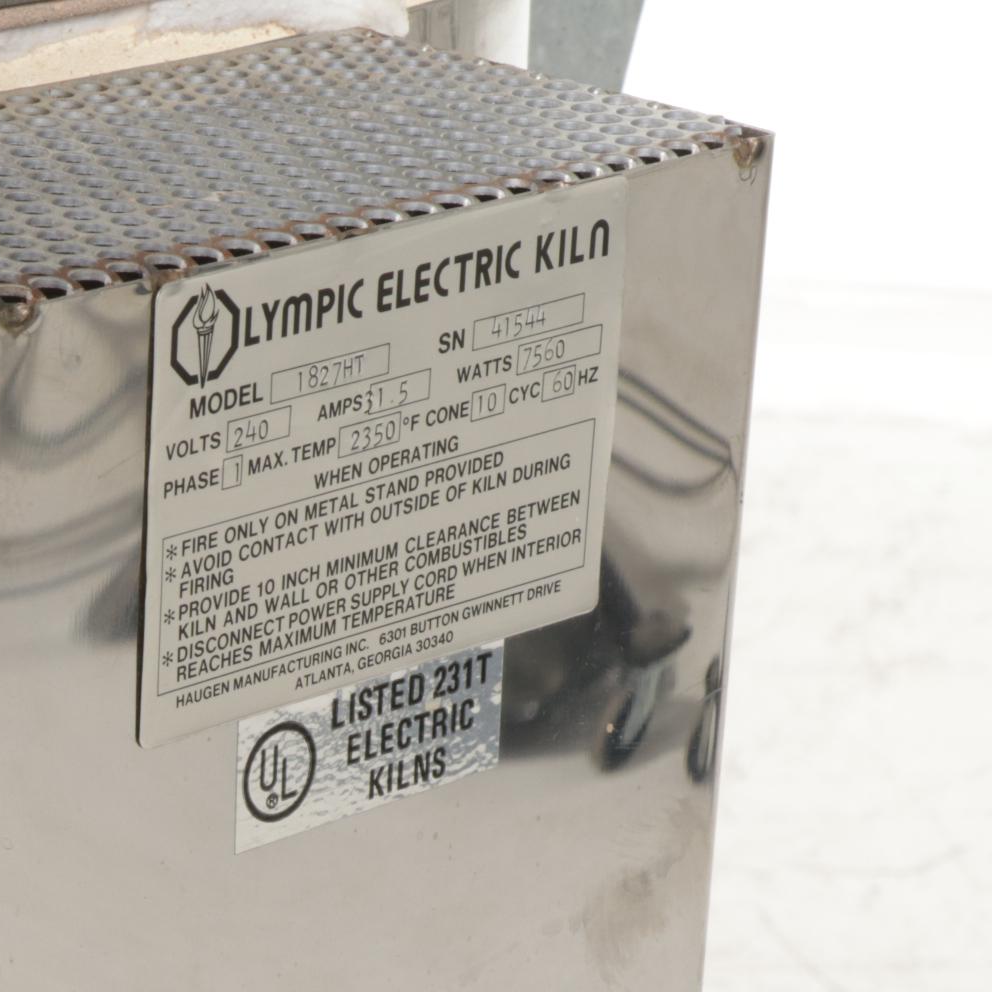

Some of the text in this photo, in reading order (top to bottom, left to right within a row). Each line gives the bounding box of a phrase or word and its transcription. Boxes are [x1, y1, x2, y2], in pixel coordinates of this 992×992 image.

[377, 240, 521, 312] ELECTRIC
[535, 219, 609, 273] KILN
[166, 432, 221, 460] VOLTS
[234, 419, 268, 448] 240
[317, 394, 362, 421] AMPS
[457, 355, 512, 383] WATTS
[523, 338, 565, 370] 7560
[189, 307, 546, 419] MODEL 1827HT SN 41544
[164, 468, 220, 499] PHASE
[235, 462, 240, 482] 1
[248, 453, 288, 476] MAX.
[292, 437, 336, 463] TEMP
[351, 420, 396, 450] 2350
[426, 401, 469, 427] CONE
[478, 392, 497, 413] 10
[509, 381, 541, 404] CYC
[552, 370, 573, 393] 60
[578, 366, 599, 386] HZ
[314, 435, 458, 489] WHEN OPERATING
[178, 490, 580, 621] PROVIDE 10 INCH MINIMUM CLEARANCE BETWEEN
[181, 451, 503, 557] FIRE ONLY ON METAL STAND PROVIDED
[181, 453, 571, 579] AVOID CONTACT WITH OUTSIDE OF KILN DURING
[176, 584, 455, 682] REACHES MAXIMUM TEMPERATURE
[177, 529, 581, 663] DISCONNECT POWER SUPPLY CORD WHEN INTERIOR
[178, 524, 527, 641] KILN AND WALL OR OTHER COMBUSTIBLES
[179, 568, 234, 599] FIRING
[176, 580, 561, 708] HAUGEN MANUFACTURING INC. 6301 BUTTON GWINNETT DRIVE
[294, 631, 453, 691] ATLANTA, GEORGIA 30340
[331, 652, 492, 730] LISTED 231T
[347, 699, 475, 766] ELECTRIC
[368, 747, 446, 799] KILNS
